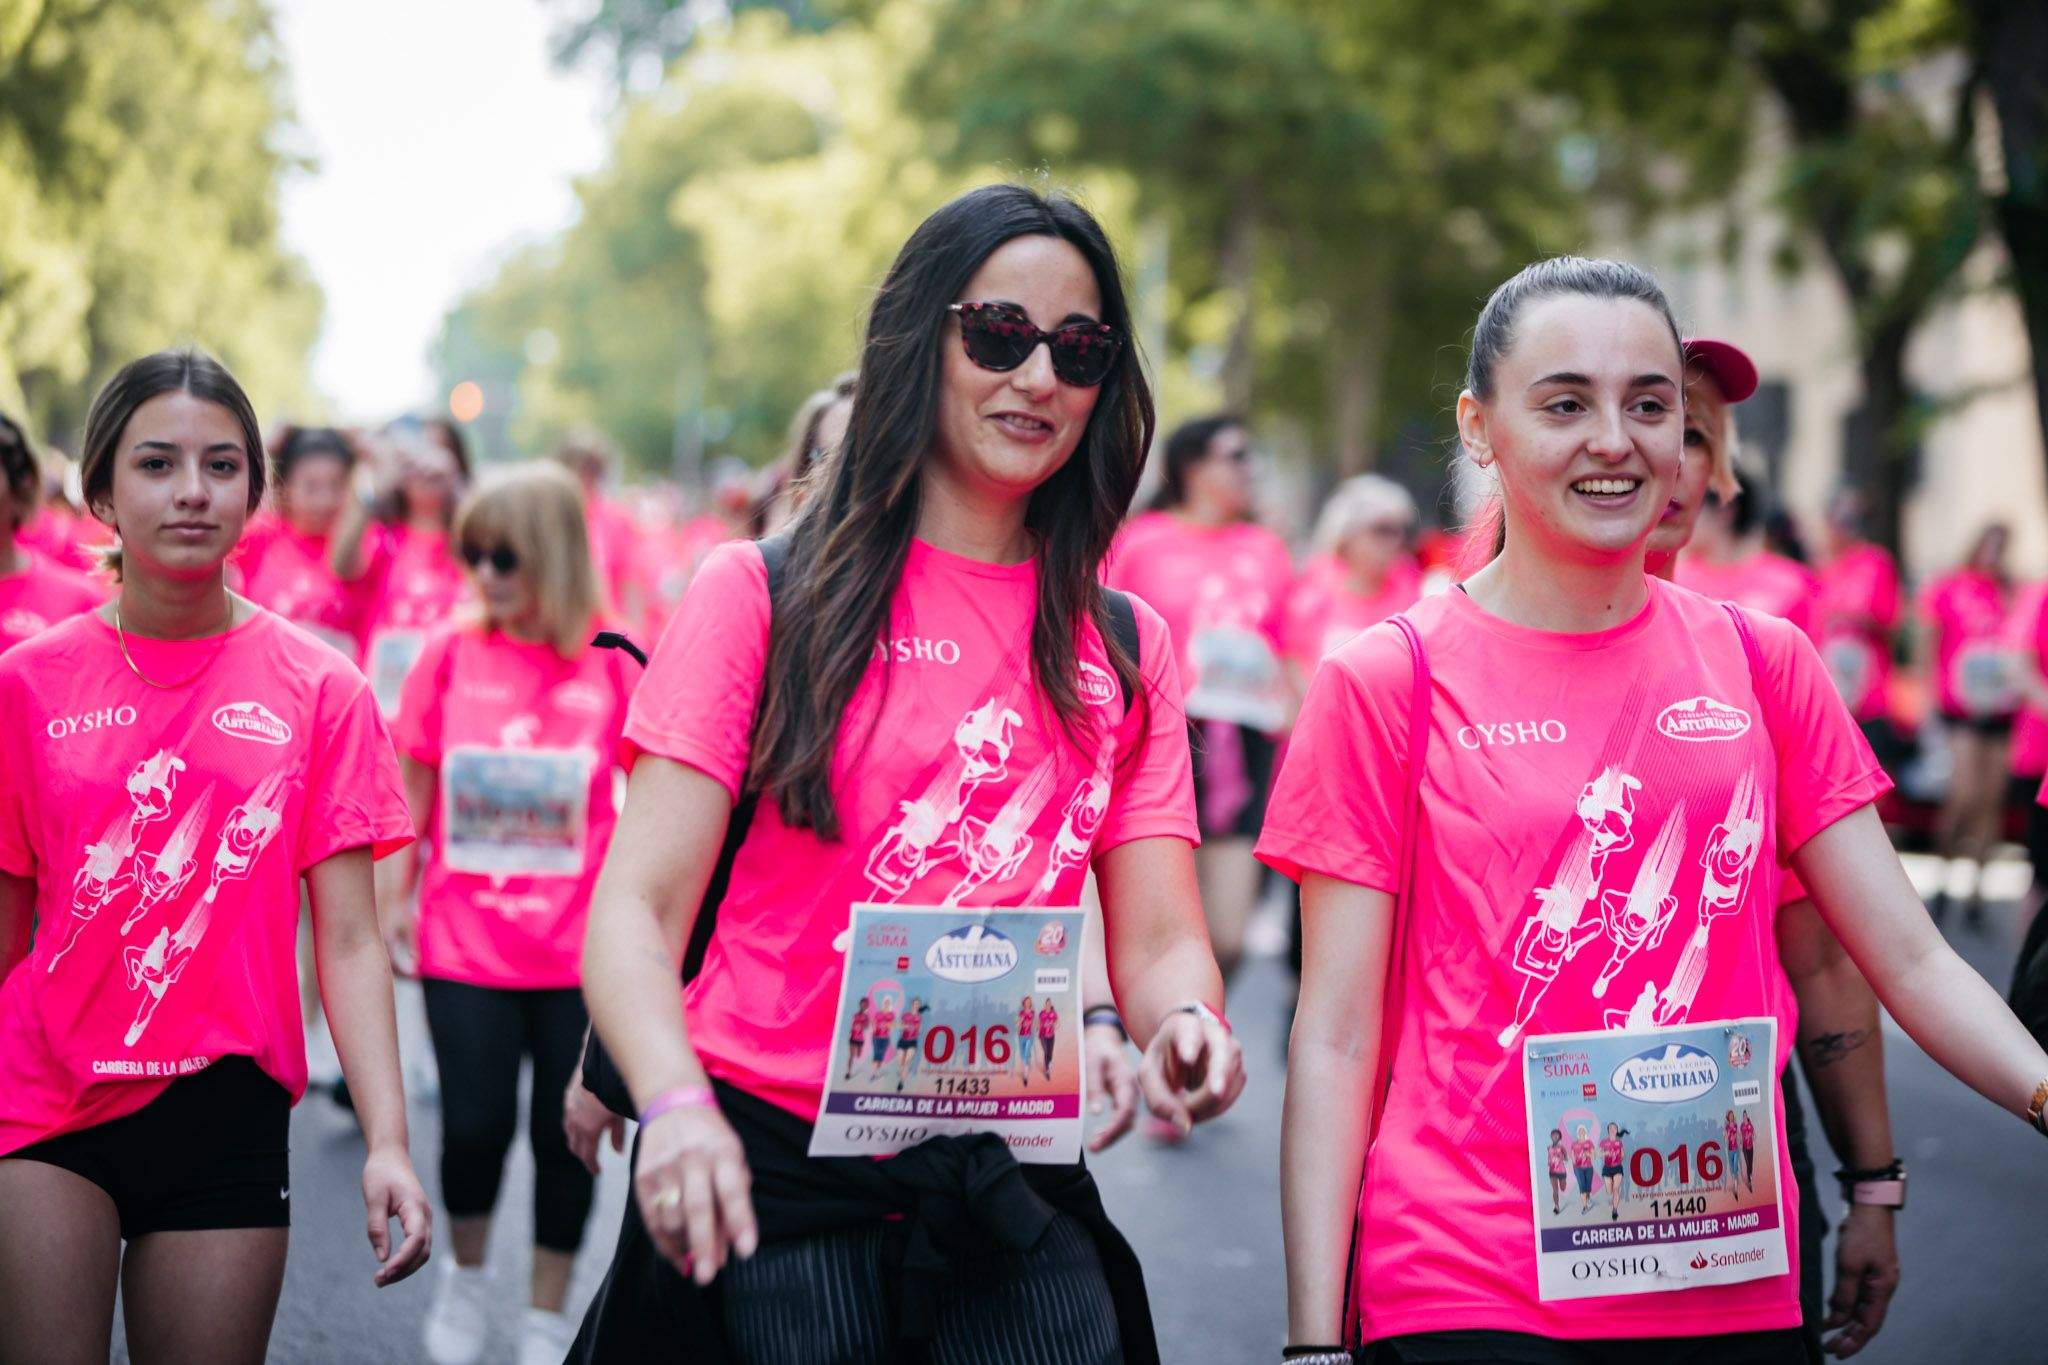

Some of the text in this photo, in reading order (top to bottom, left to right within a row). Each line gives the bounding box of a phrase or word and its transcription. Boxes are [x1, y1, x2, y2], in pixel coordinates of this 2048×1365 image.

[869, 636, 961, 665] YSHO
[47, 706, 137, 739] OYSHO
[220, 711, 286, 739] ASTURIANA
[1666, 715, 1745, 733] ASTURIANA
[1457, 719, 1567, 750] OYSHO
[934, 948, 1012, 969] ASTURIANA
[923, 1024, 1011, 1065] 016
[92, 1056, 211, 1076] CARRERA DE LA MUJER
[1544, 1062, 1590, 1078] SUMA
[935, 1077, 990, 1095] 11433
[1622, 1068, 1715, 1091] ASTURIANA
[854, 1096, 914, 1114] CARRERA
[916, 1099, 933, 1114] DE
[936, 1099, 953, 1115] LA
[956, 1100, 999, 1116] MUJER
[1007, 1100, 1055, 1115] MADRID
[845, 1125, 928, 1142] OYSHO
[1629, 1141, 1723, 1188] 016
[1650, 1196, 1707, 1218] 11440
[1572, 1229, 1634, 1246] CARRERA
[1637, 1224, 1655, 1239] DE
[1659, 1222, 1676, 1239] LA
[1679, 1219, 1719, 1237] MUJER
[1727, 1212, 1759, 1231] MADRID
[1571, 1255, 1659, 1281] OYSHO
[1711, 1248, 1766, 1269] Santander
